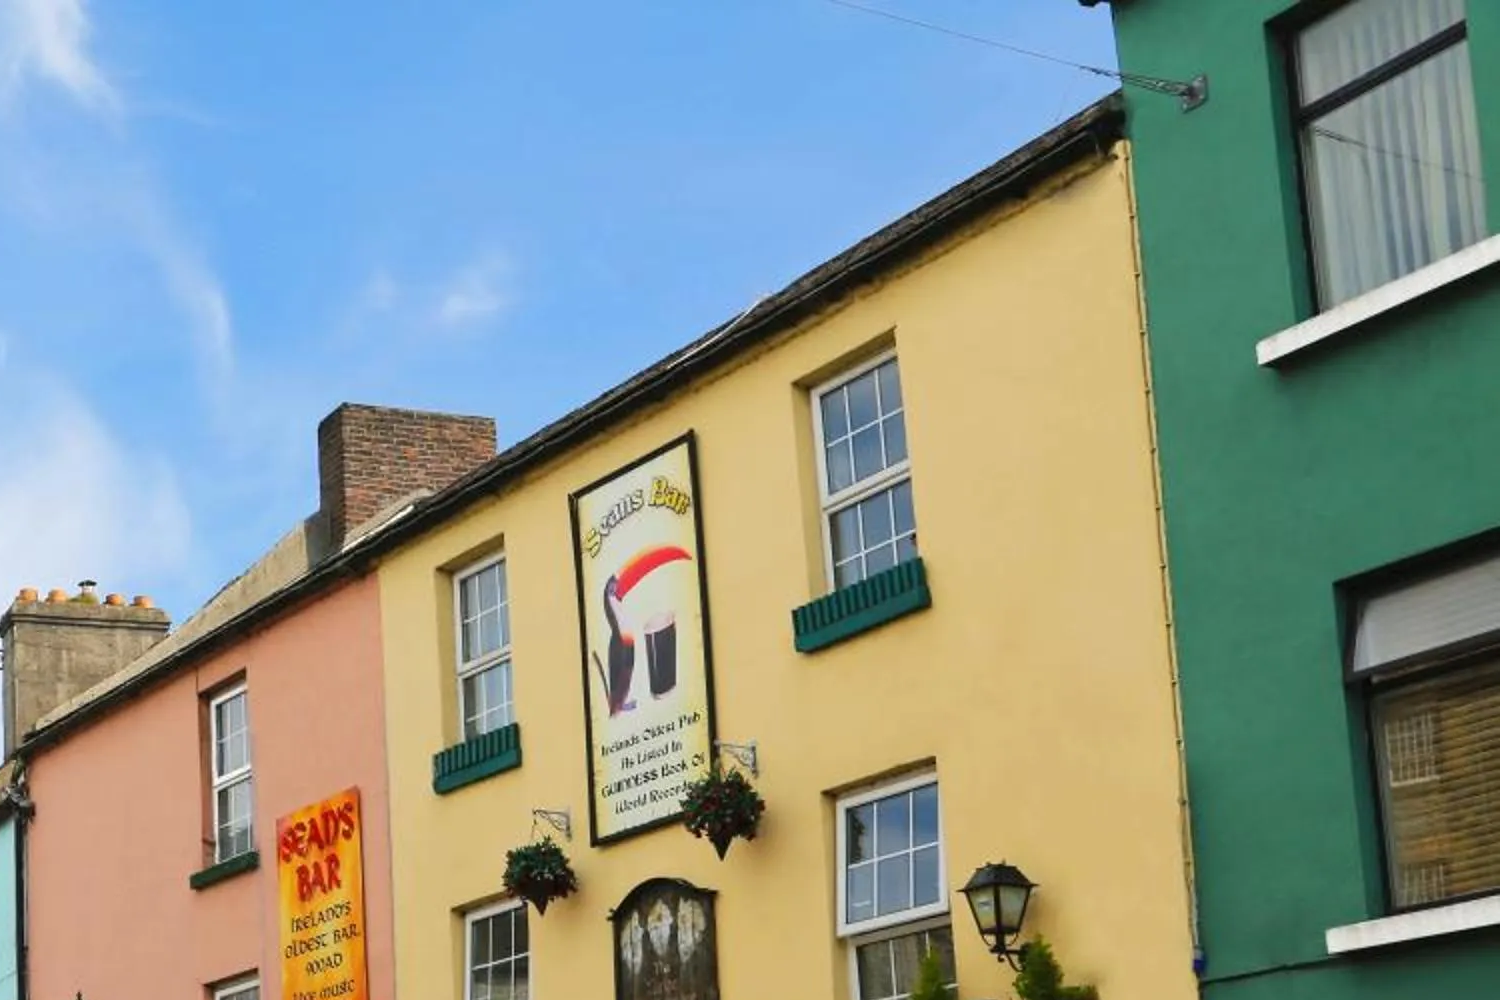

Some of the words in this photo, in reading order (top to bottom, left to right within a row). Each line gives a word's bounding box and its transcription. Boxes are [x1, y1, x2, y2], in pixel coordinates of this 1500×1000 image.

[649, 476, 690, 515] Bar
[679, 711, 701, 729] Pub
[661, 759, 688, 778] Book
[615, 793, 647, 815] World
[296, 853, 342, 902] BAR
